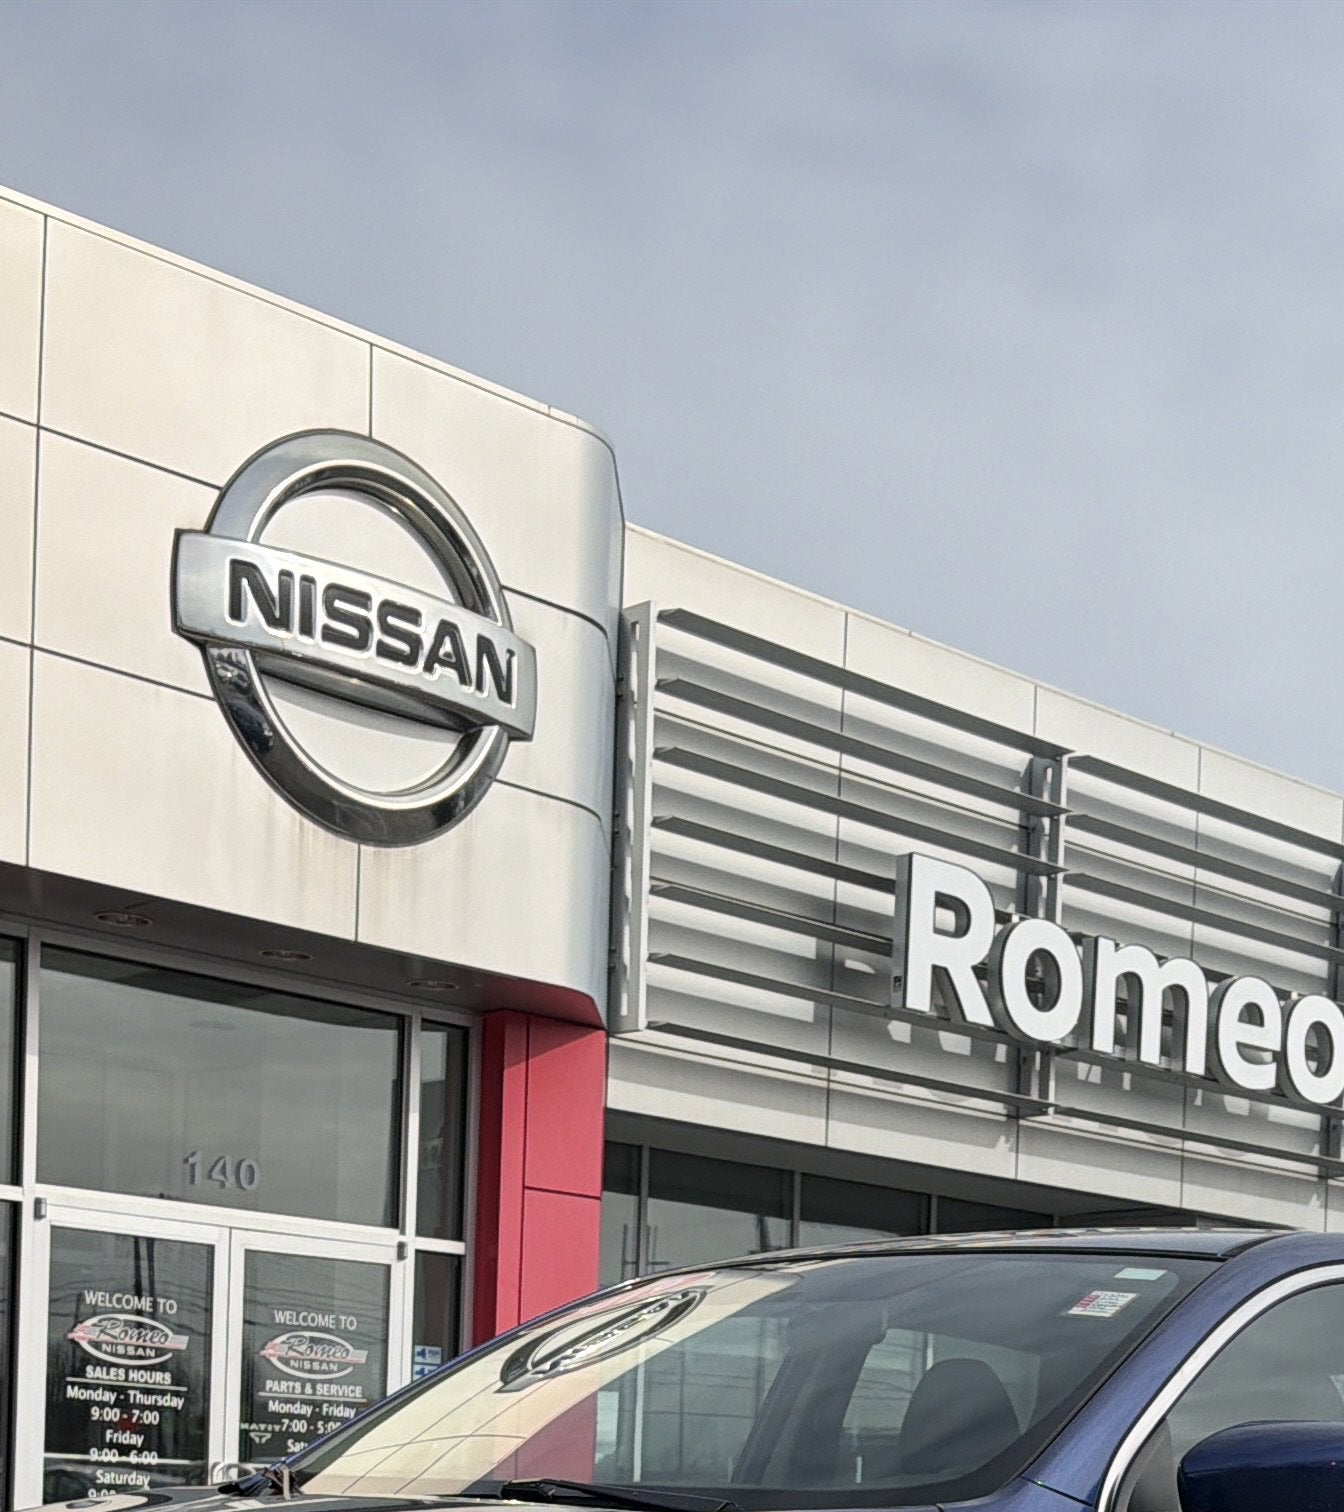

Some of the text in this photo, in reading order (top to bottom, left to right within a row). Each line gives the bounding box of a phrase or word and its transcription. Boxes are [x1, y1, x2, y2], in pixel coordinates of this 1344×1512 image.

[226, 558, 515, 706] NISSAN
[183, 1150, 261, 1191] 140
[84, 1290, 178, 1314] WELCOME TO
[92, 1317, 170, 1344] Romeo
[274, 1310, 358, 1331] WELCOME TO
[101, 1344, 156, 1357] NISSAN
[283, 1334, 351, 1359] Romeo
[85, 1365, 171, 1385] SALES HOURS
[289, 1359, 338, 1372] NISSAN
[66, 1385, 117, 1405] Monday
[127, 1390, 185, 1410] Thursday
[265, 1380, 363, 1398] PARTS & SERVICE
[90, 1407, 120, 1422] 9:00
[131, 1410, 160, 1425] 7:00
[268, 1400, 313, 1416] Monday
[322, 1403, 356, 1419] Friday
[281, 1419, 307, 1433] 7:00
[105, 1429, 145, 1448] Friday
[89, 1448, 118, 1462] 9:00
[129, 1451, 158, 1465] 6:00
[95, 1471, 150, 1491] Saturday
